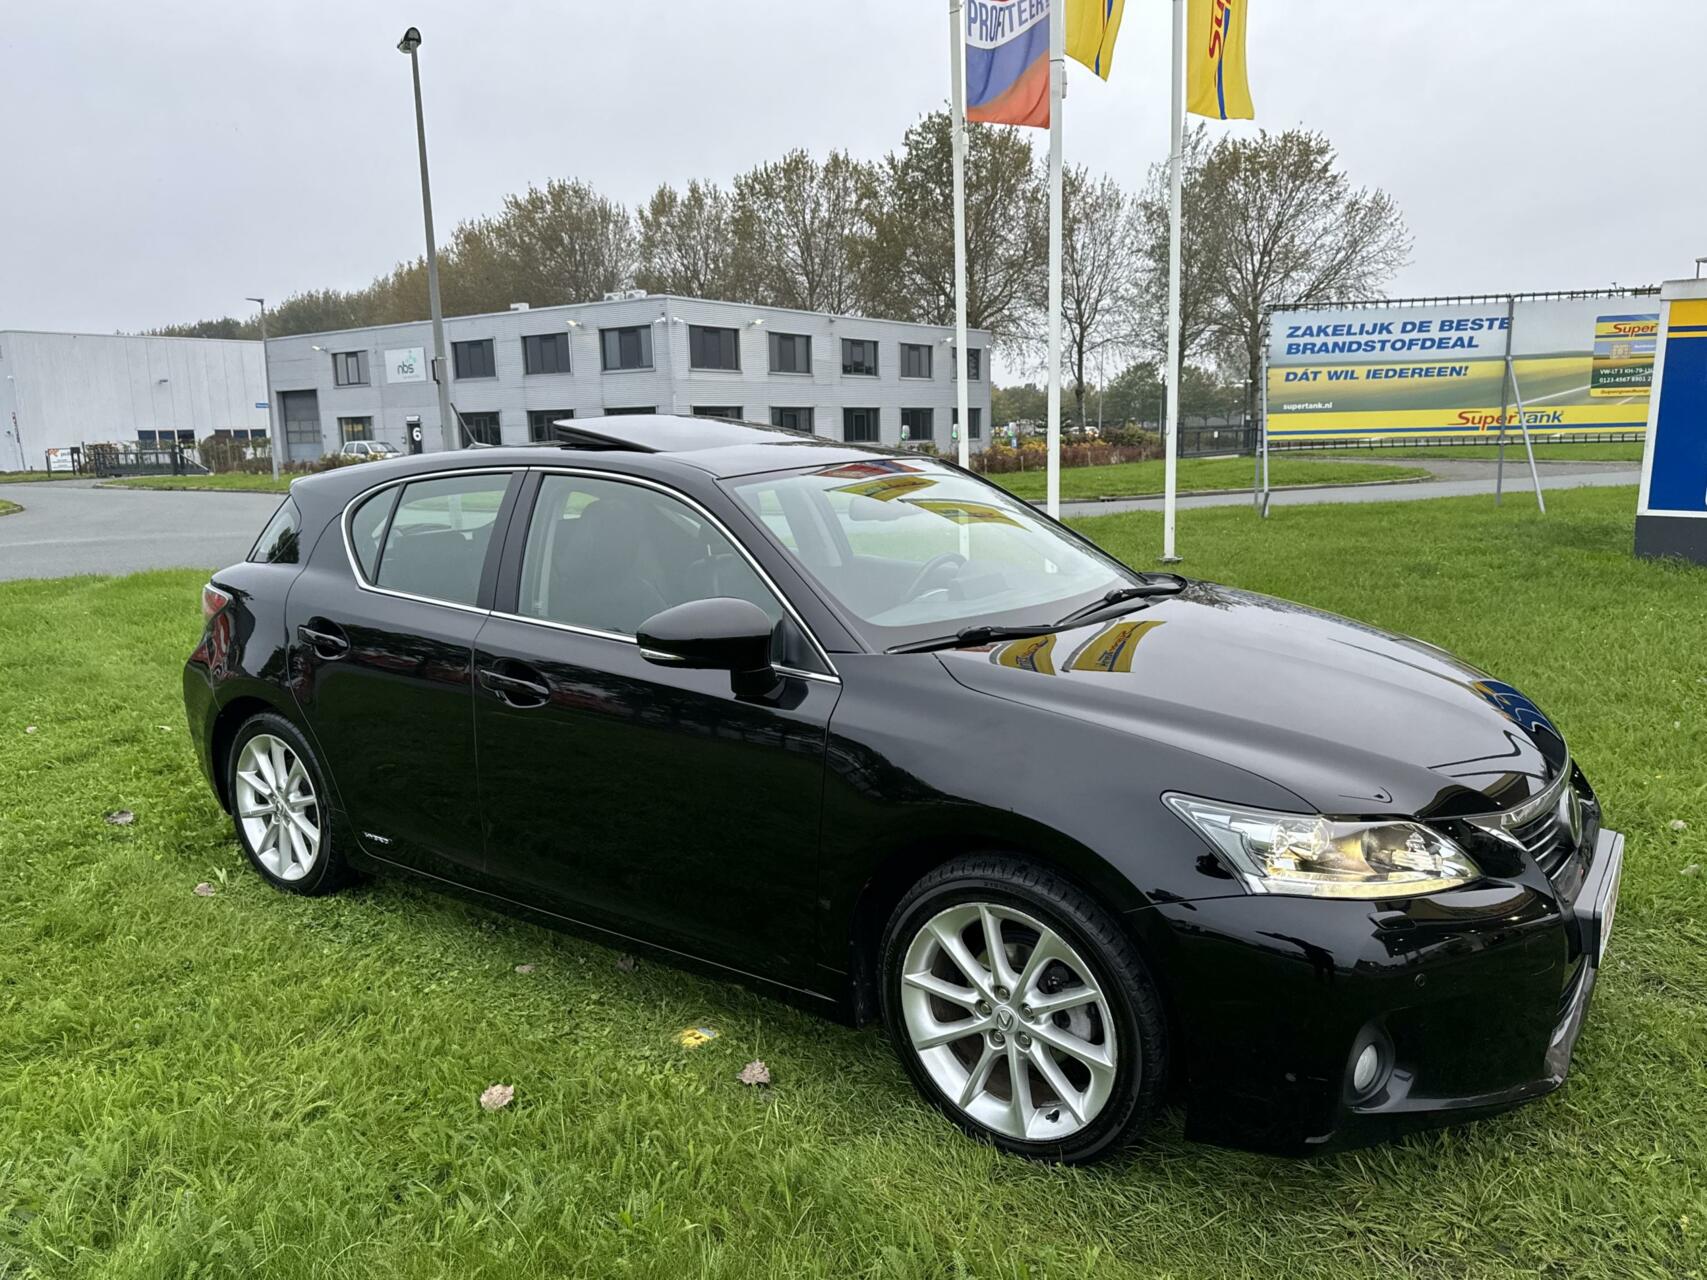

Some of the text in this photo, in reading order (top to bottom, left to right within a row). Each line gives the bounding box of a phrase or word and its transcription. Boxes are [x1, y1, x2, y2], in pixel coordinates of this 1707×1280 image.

[1286, 316, 1513, 338] ZAKELIJK DE BESTE
[1609, 322, 1657, 338] Super
[1286, 336, 1480, 355] BRANDSTOFDEAL
[397, 361, 415, 374] nbs
[1284, 366, 1469, 382] DÁT WIL IEDEREEN!
[1283, 402, 1333, 410] supertank.nl
[412, 427, 422, 441] 6
